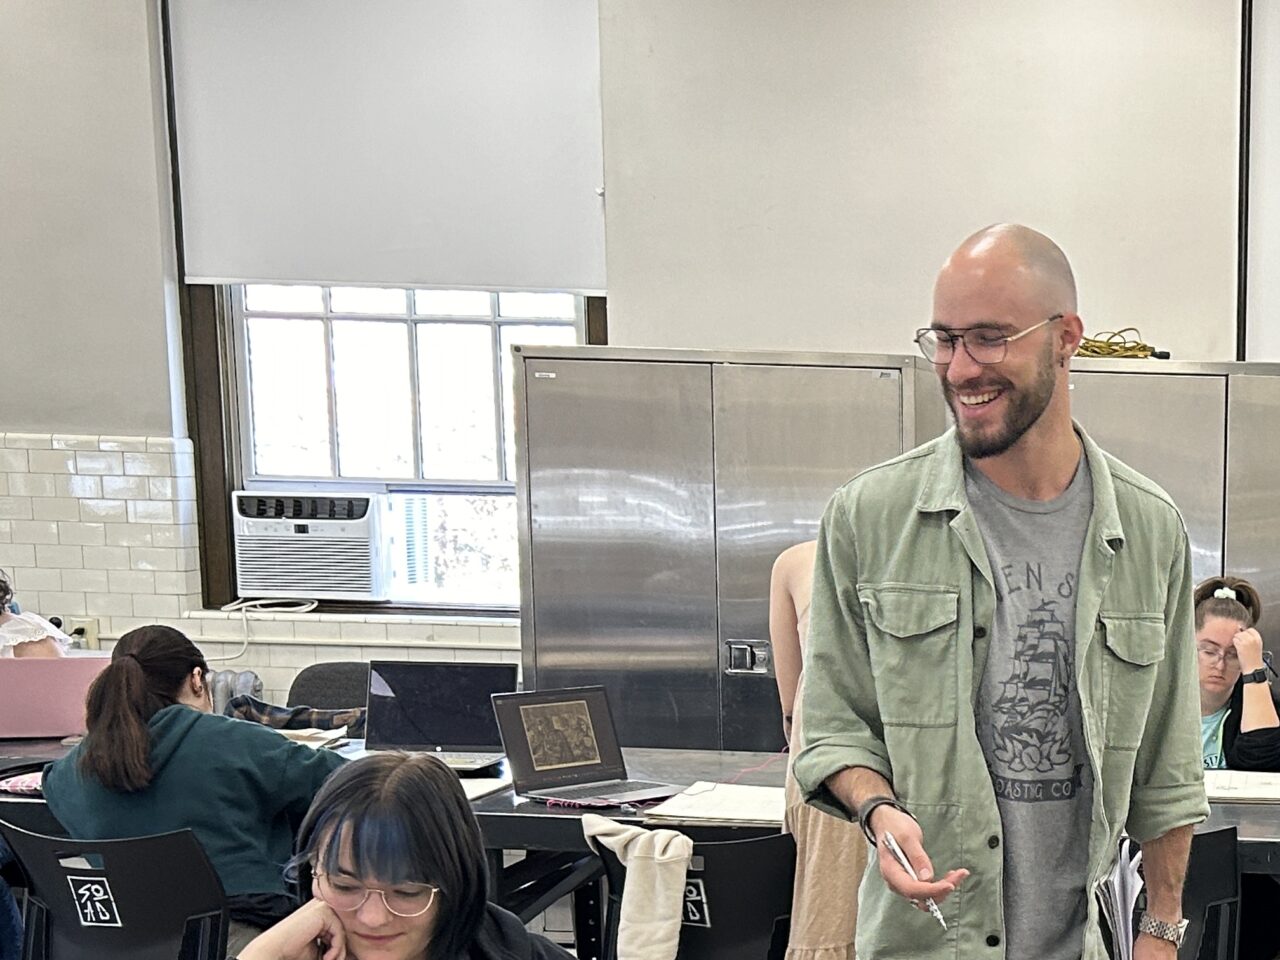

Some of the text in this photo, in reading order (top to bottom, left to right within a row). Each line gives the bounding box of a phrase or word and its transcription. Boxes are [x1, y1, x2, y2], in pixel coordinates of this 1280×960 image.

[1001, 561, 1075, 599] EN S
[1051, 781, 1072, 797] CO
